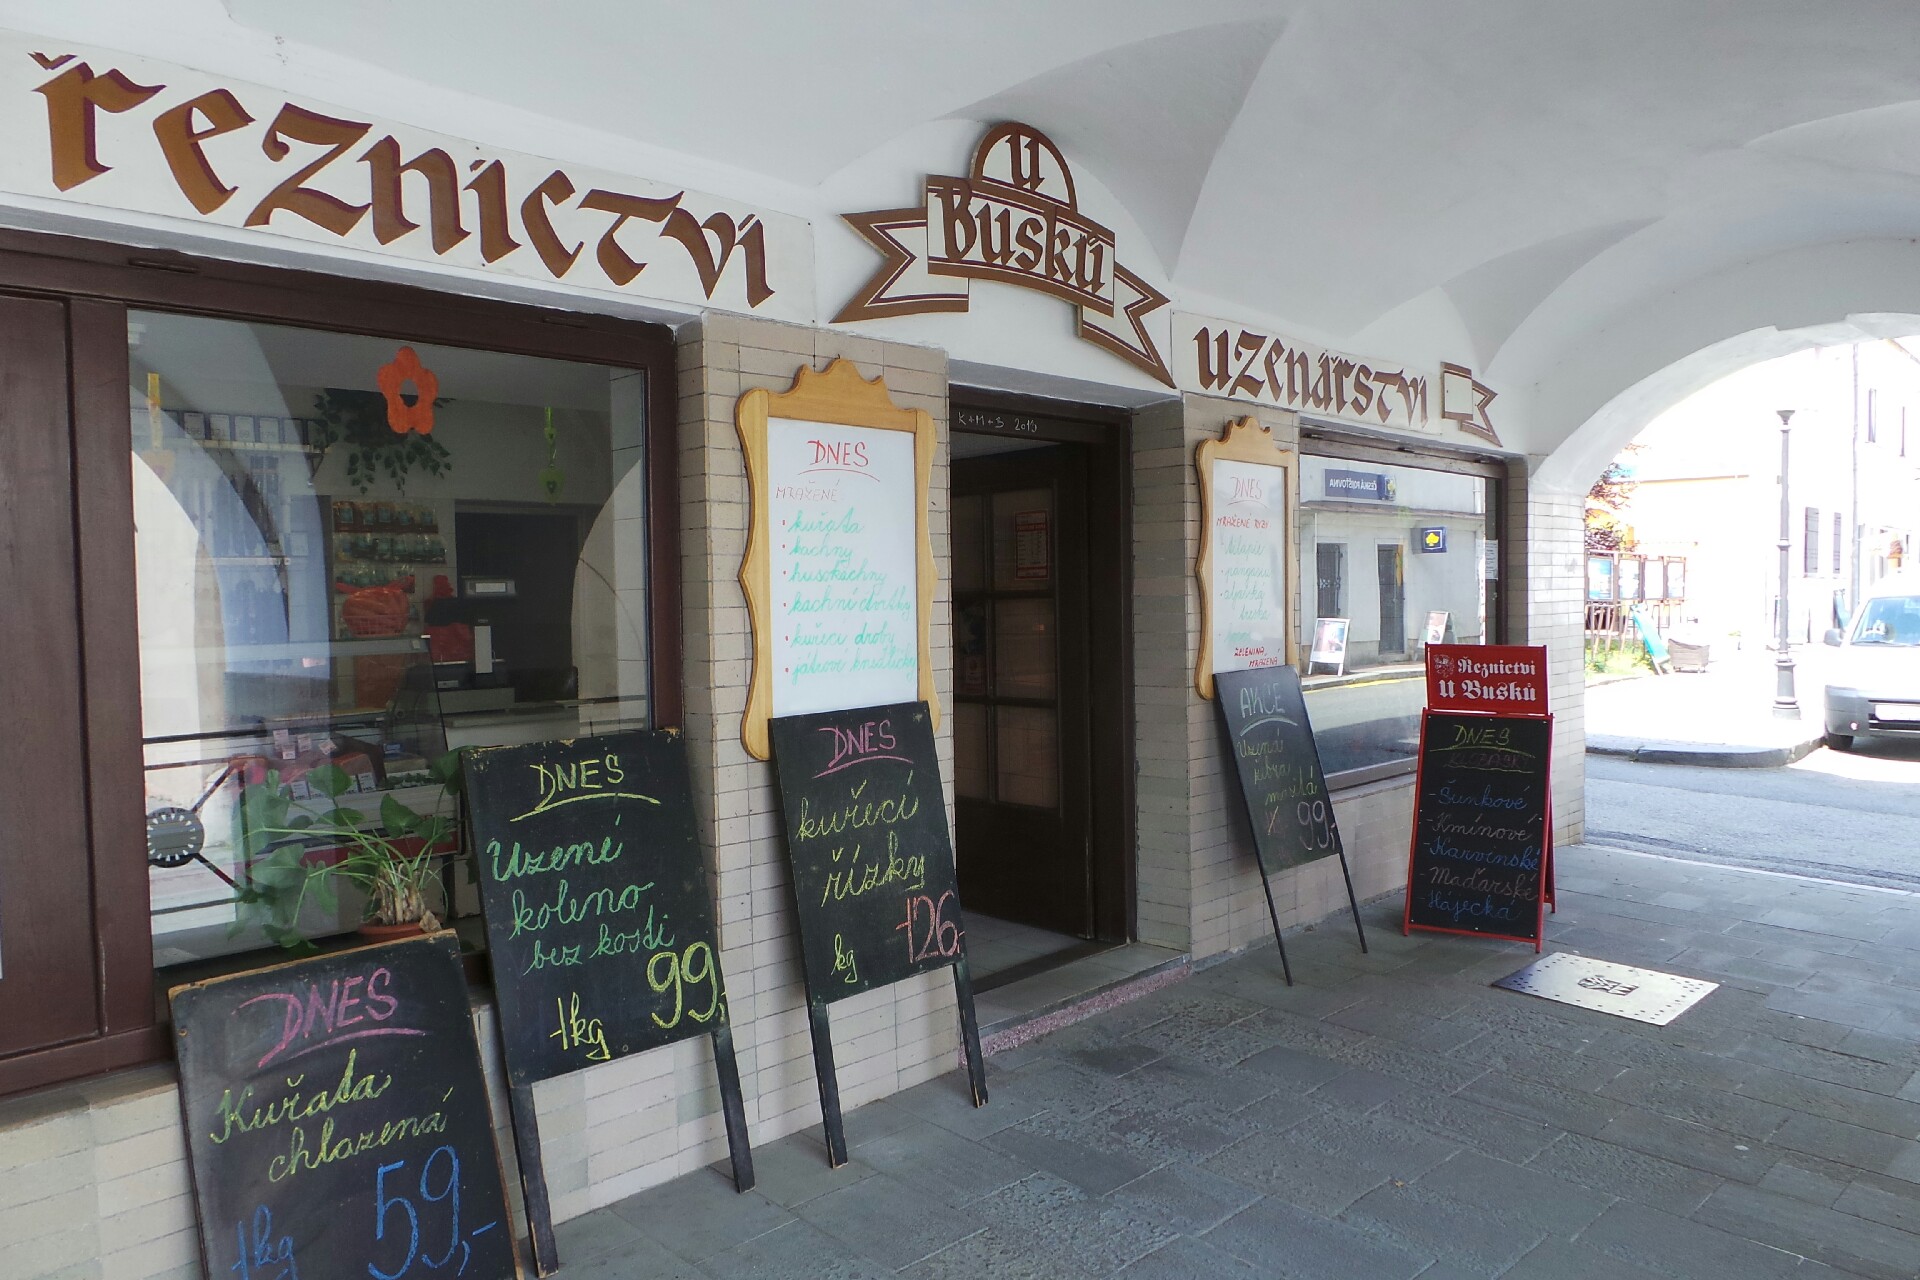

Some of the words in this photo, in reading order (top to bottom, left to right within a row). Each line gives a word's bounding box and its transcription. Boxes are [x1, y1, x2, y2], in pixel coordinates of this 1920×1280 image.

[1193, 326, 1429, 428] uzenářství
[807, 440, 869, 467] DNES
[1230, 476, 1262, 499] DNES
[788, 506, 864, 534] kuřata
[1240, 683, 1285, 718] AKCE
[1439, 679, 1456, 699] U
[819, 719, 897, 768] DNES
[1453, 725, 1511, 746] DNES
[530, 754, 625, 811] DNES
[796, 769, 919, 842] kuřecí
[821, 831, 926, 907] řízky
[508, 879, 655, 940] koleno
[523, 940, 582, 976] bez
[831, 933, 858, 983] kg
[231, 967, 398, 1068] DNES
[549, 991, 612, 1060] 1kg
[210, 1048, 392, 1145] Kuřata
[268, 1086, 454, 1184] chlazená
